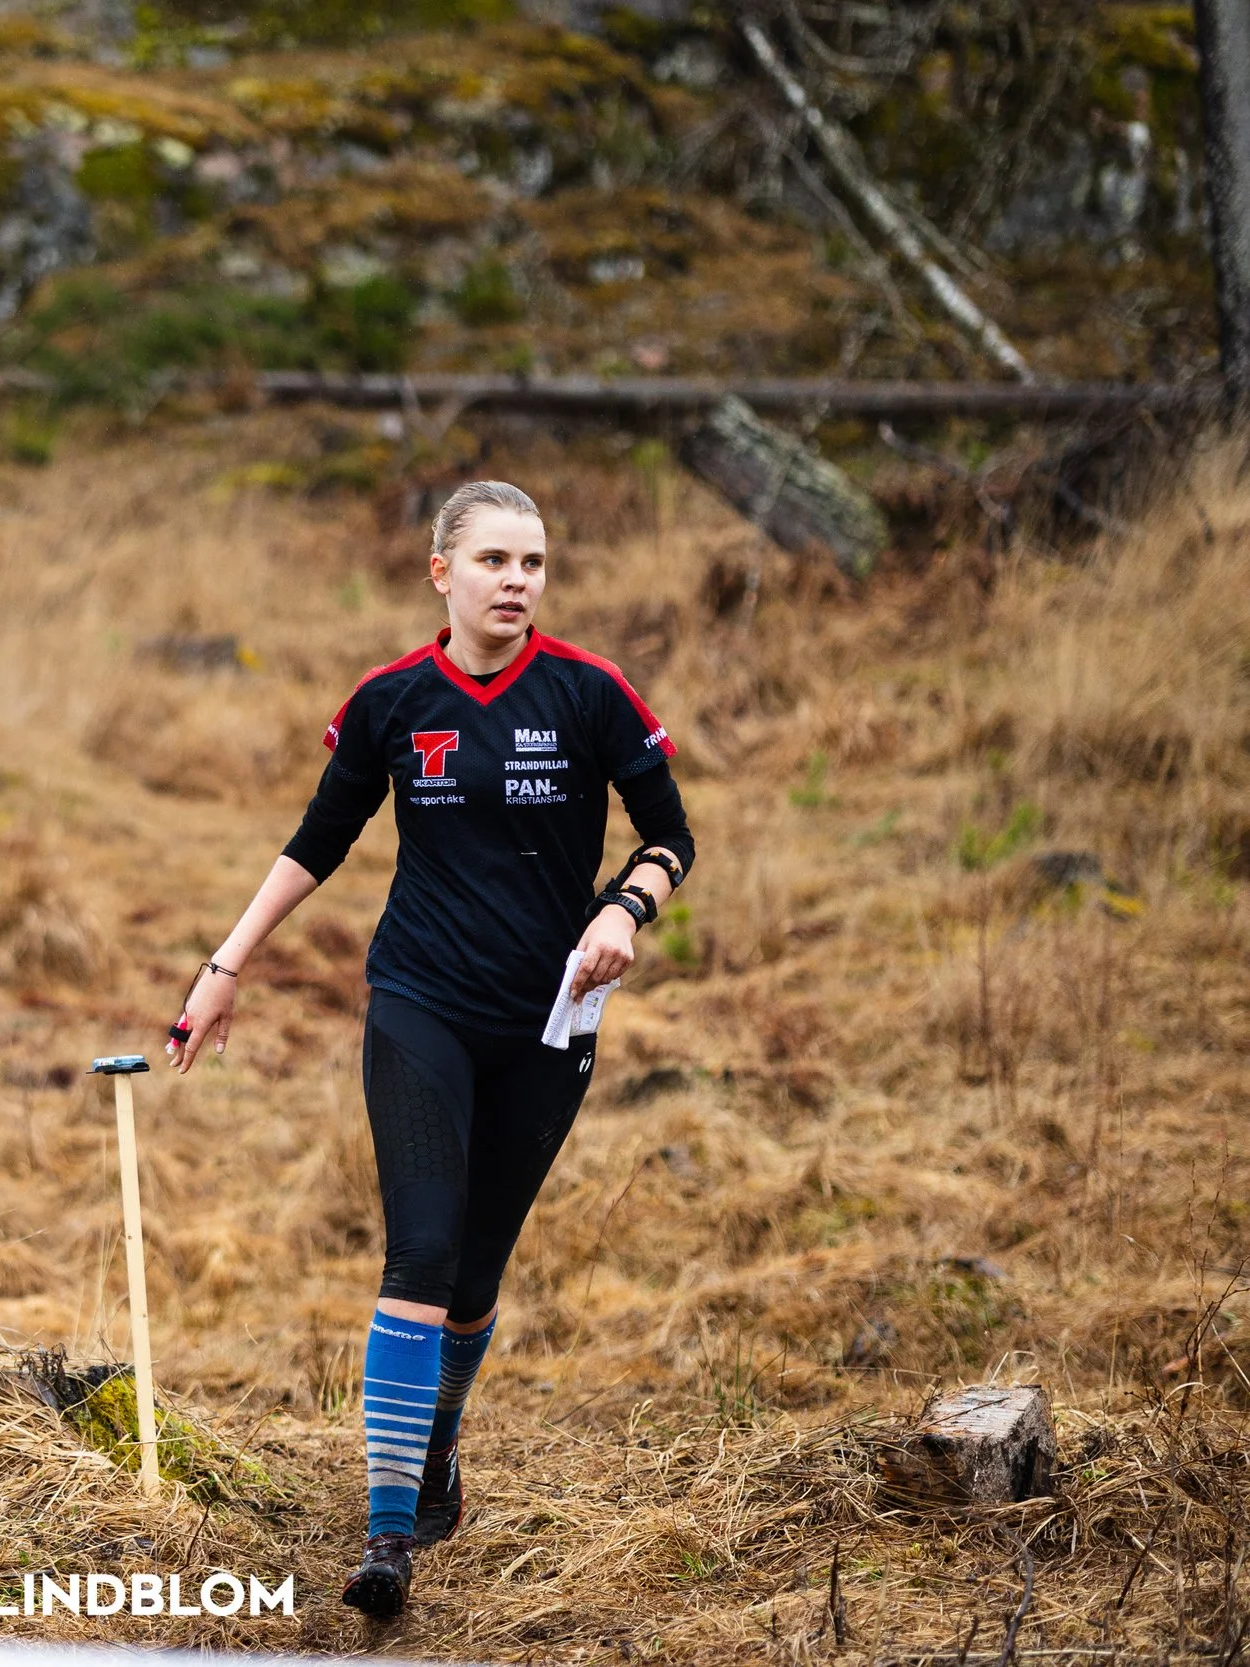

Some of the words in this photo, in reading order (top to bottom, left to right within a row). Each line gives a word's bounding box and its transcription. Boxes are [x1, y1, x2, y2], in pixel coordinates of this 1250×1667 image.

[505, 760, 568, 771] STRANDVILLAN
[506, 779, 557, 796] PAN-
[506, 794, 567, 805] KRISTIANSTAD
